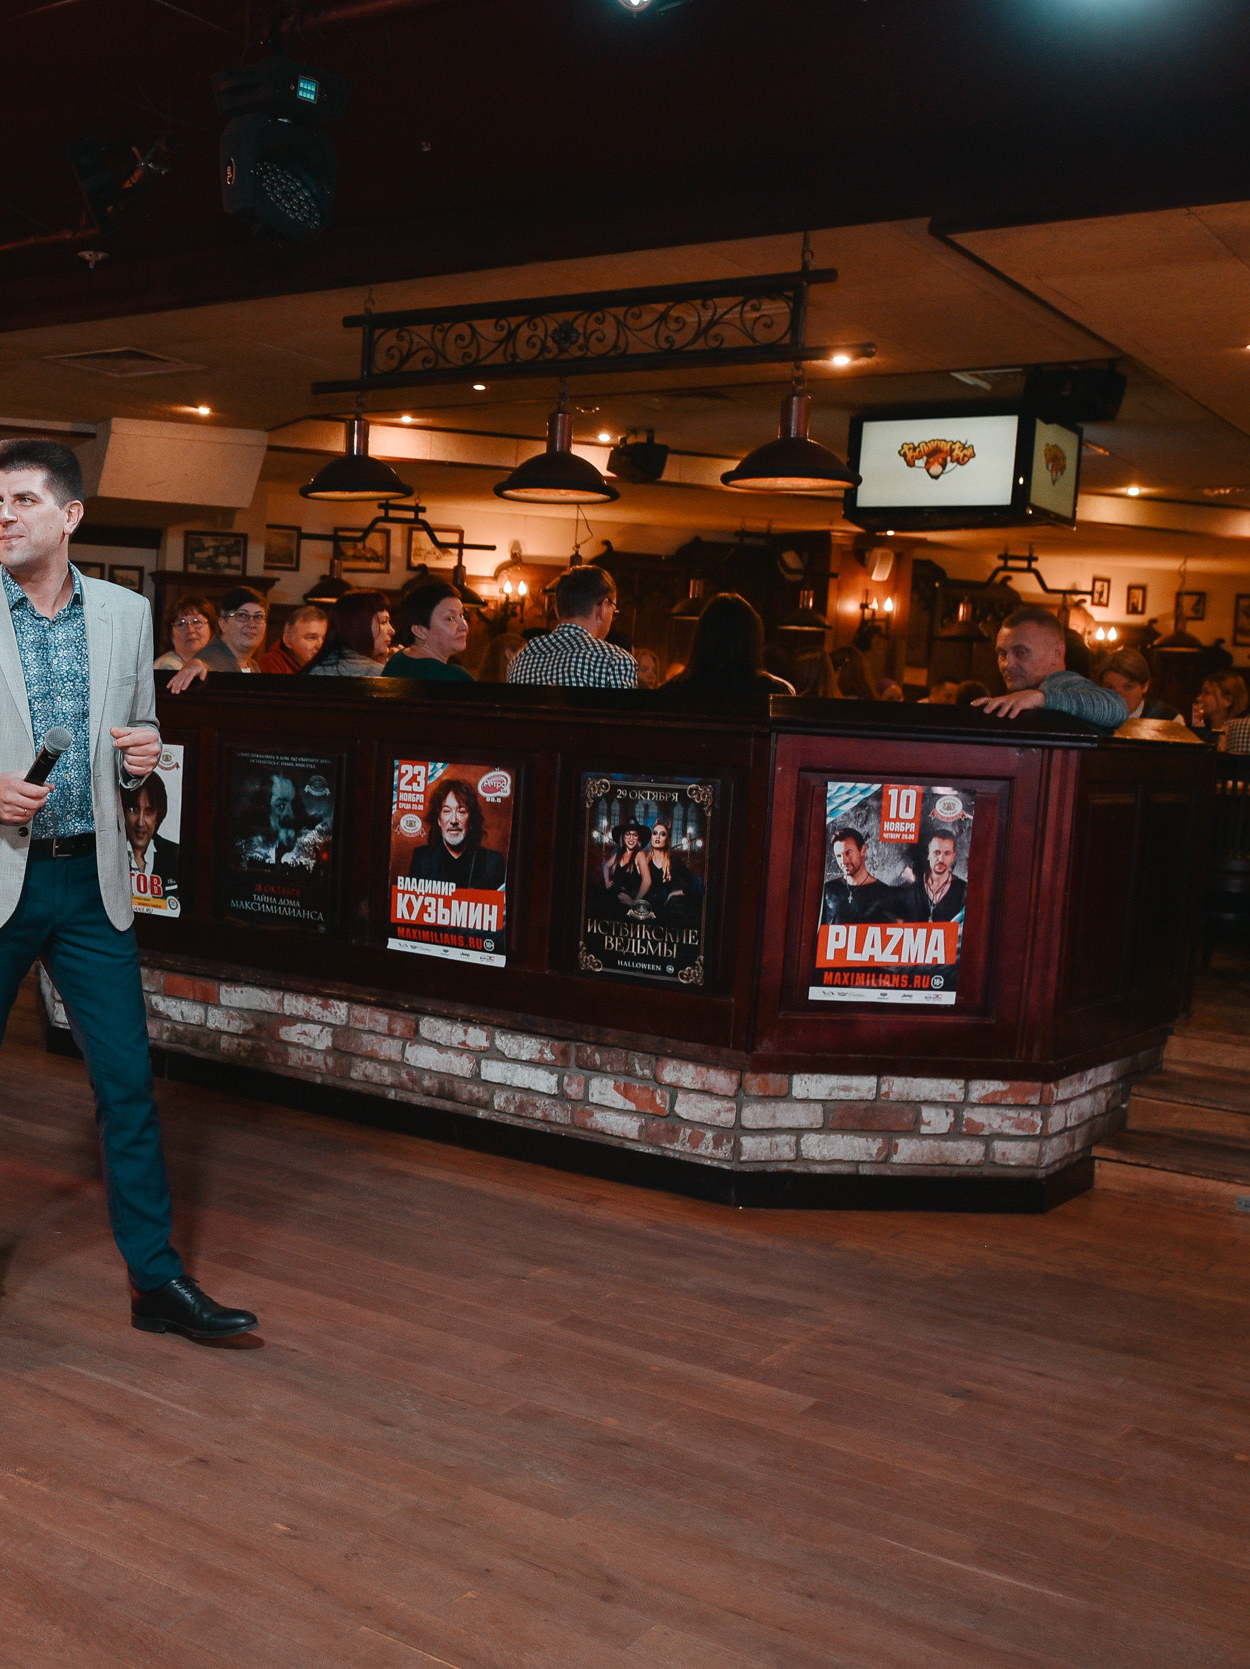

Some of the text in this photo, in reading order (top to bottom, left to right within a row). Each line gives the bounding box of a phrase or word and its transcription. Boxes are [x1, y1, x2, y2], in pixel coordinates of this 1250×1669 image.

[399, 764, 426, 792] 23
[399, 792, 425, 803] НОЯБРЯ
[616, 788, 679, 802] 29 ОКТЯБРЯ
[888, 788, 917, 819] 10
[883, 821, 916, 833] НОЯБРЯ
[397, 876, 456, 896] ВЛАДИМИР
[230, 899, 324, 921] МАКСИМИЛИАНСА
[253, 893, 301, 908] ТАЙНА ДОМА
[396, 893, 498, 932] КУЗЬМИН
[397, 926, 483, 950] MAXIMILIANS.RU
[587, 918, 699, 945] ИСТВИКСКИЕ
[604, 936, 677, 958] ВЕДЬМЫ
[826, 924, 945, 964] PLAZMA
[617, 959, 662, 971] HALLOWEEN
[823, 971, 931, 988] MAXIMILIANS.RU
